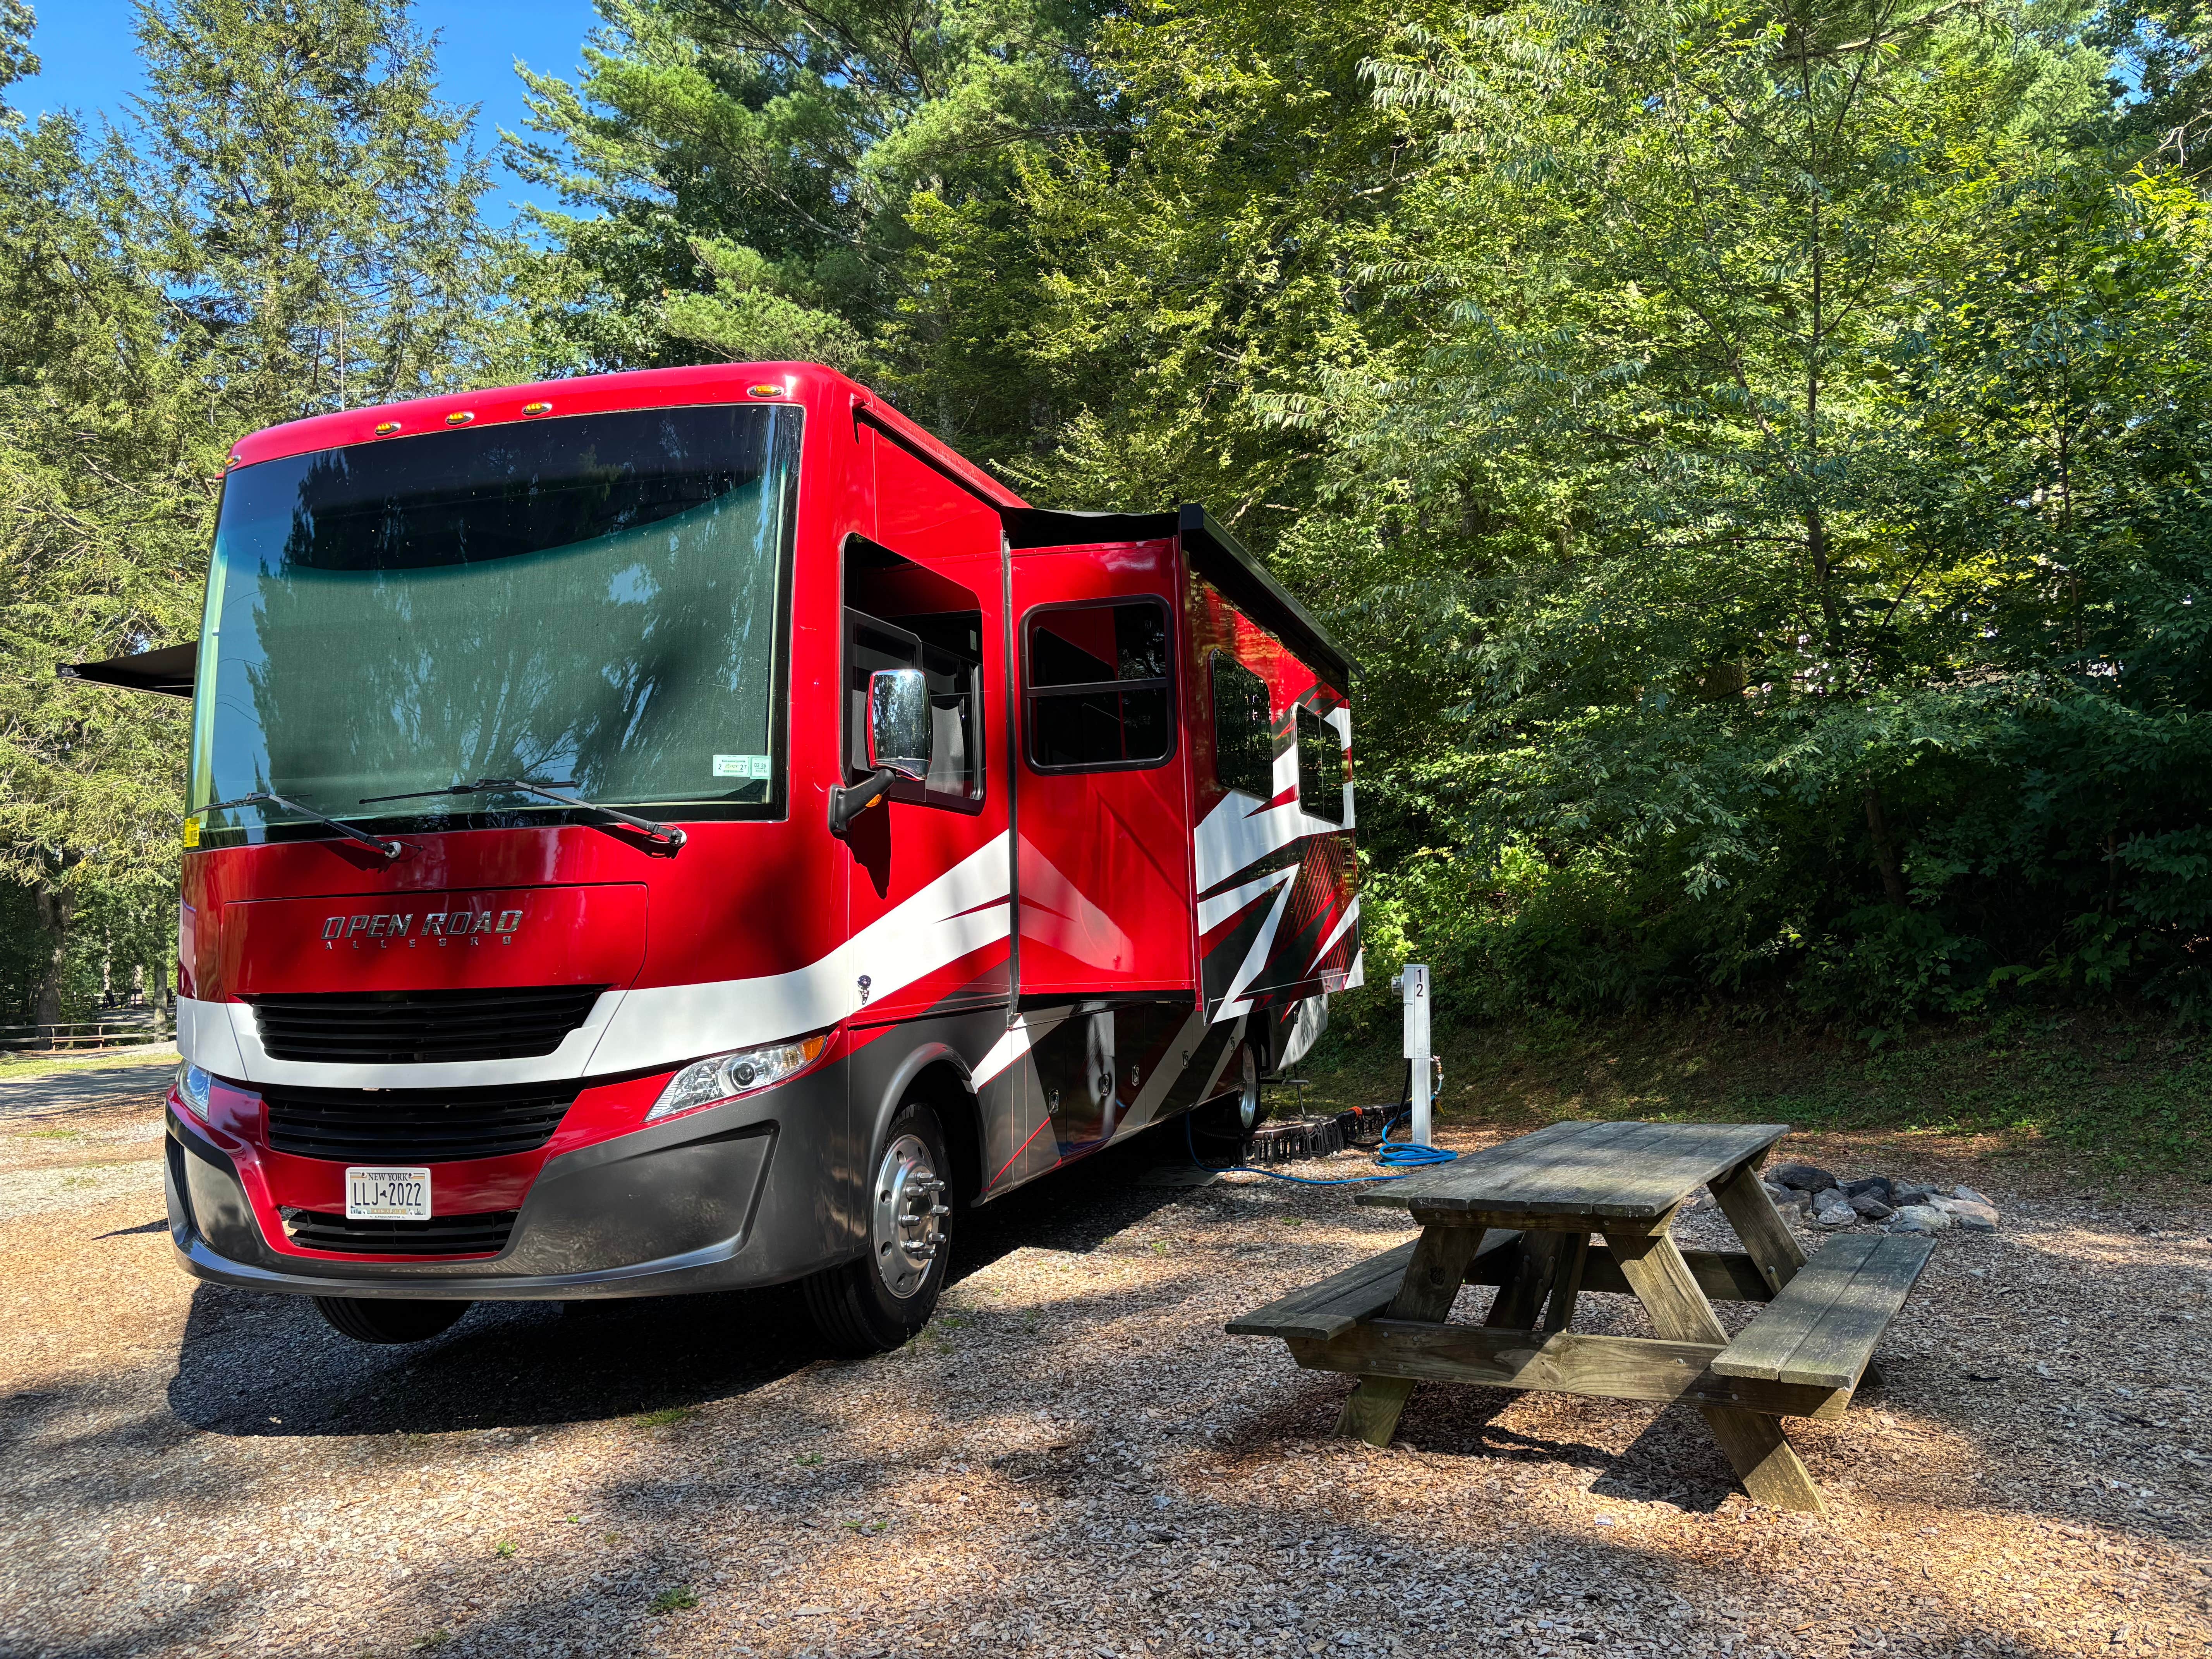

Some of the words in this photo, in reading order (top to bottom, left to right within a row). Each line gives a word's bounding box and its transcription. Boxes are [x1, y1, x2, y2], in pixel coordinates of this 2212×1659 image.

[321, 914, 413, 939] OPEN
[421, 910, 523, 936] ROAD
[325, 936, 511, 950] ALLEGRO
[386, 1173, 408, 1181] YORK
